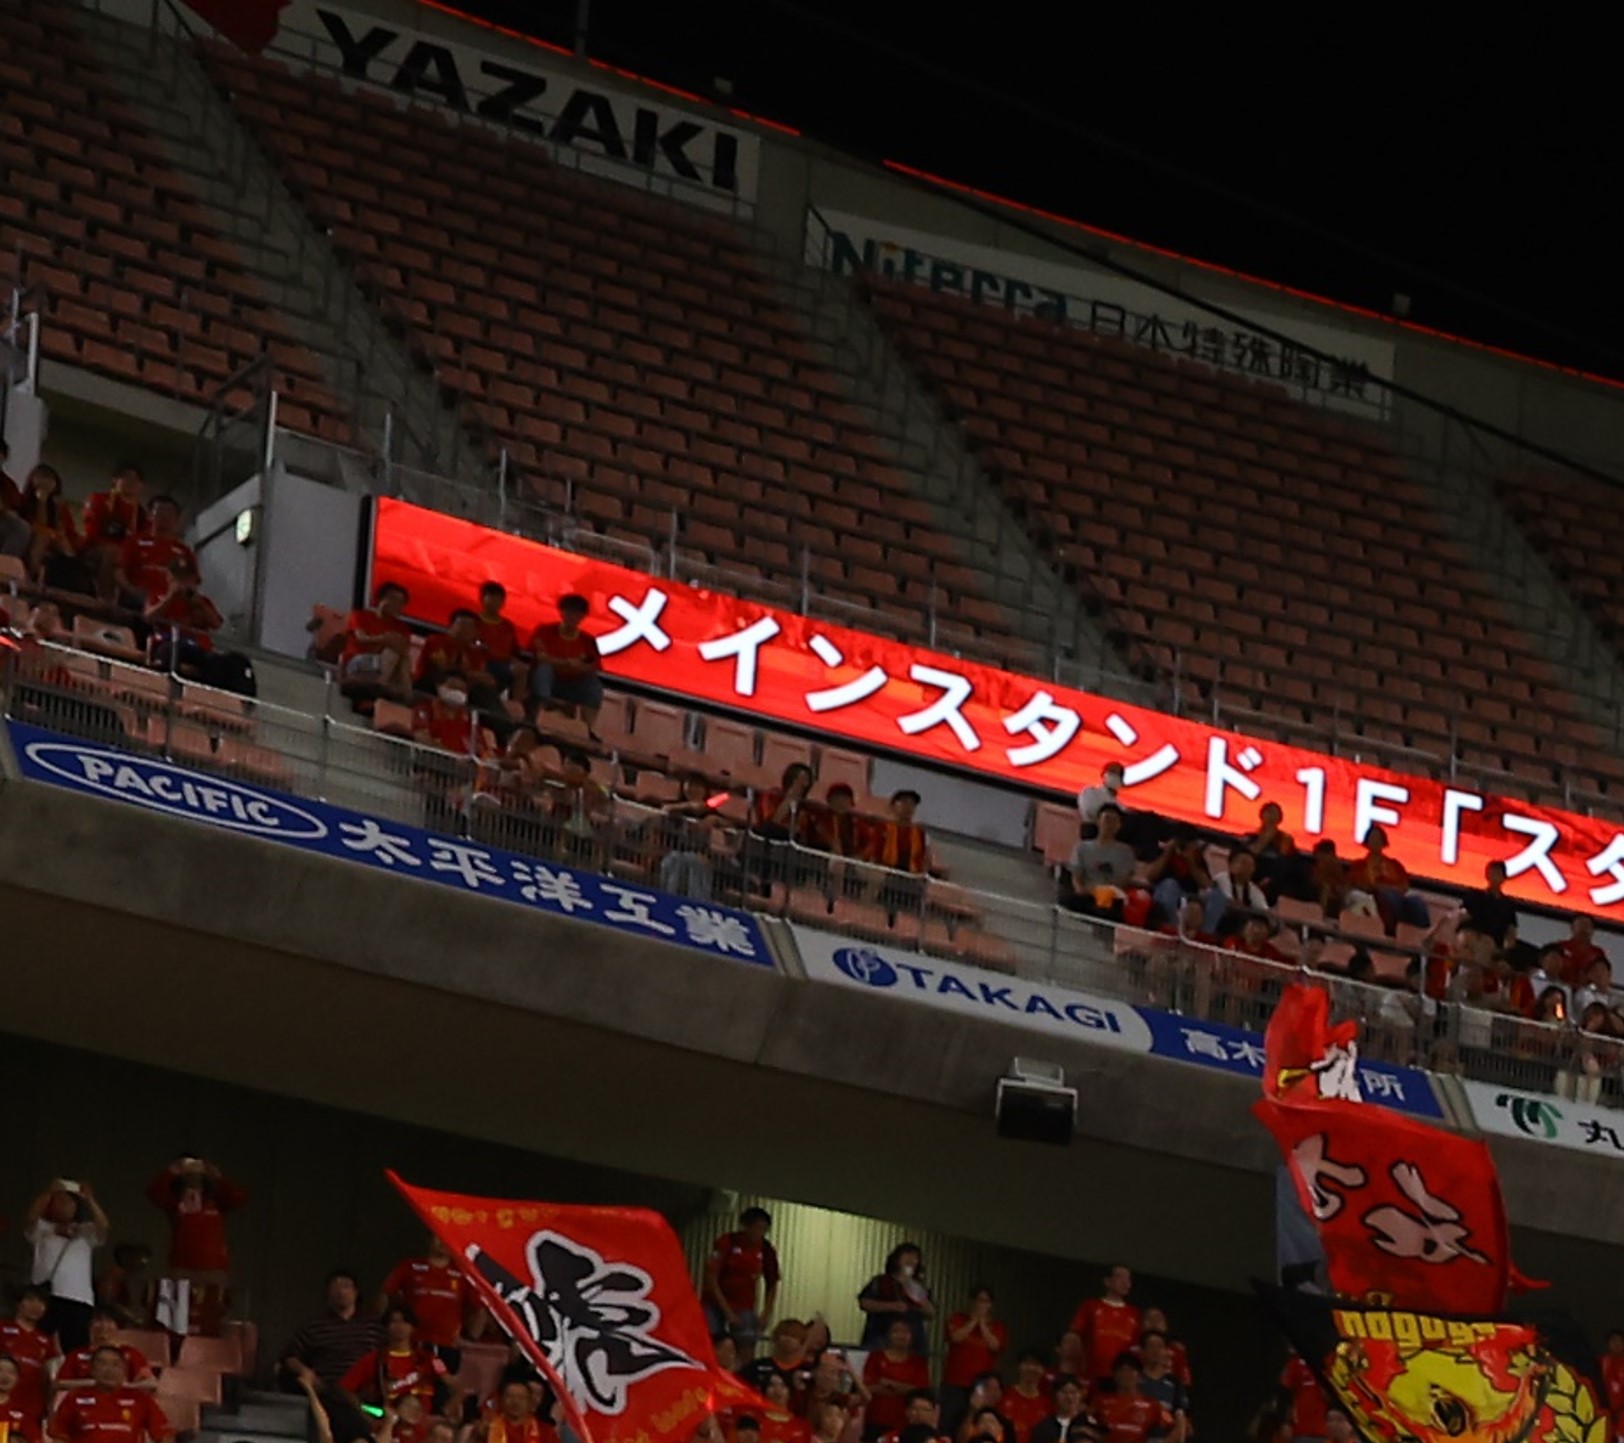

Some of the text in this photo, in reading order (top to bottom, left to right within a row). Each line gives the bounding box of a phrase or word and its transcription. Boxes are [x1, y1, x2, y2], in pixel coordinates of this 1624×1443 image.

[315, 11, 739, 193] YAZAKI
[77, 753, 281, 828] PACIFIC
[338, 818, 757, 957] 太平洋工業
[903, 963, 1123, 1036] TAKAGI
